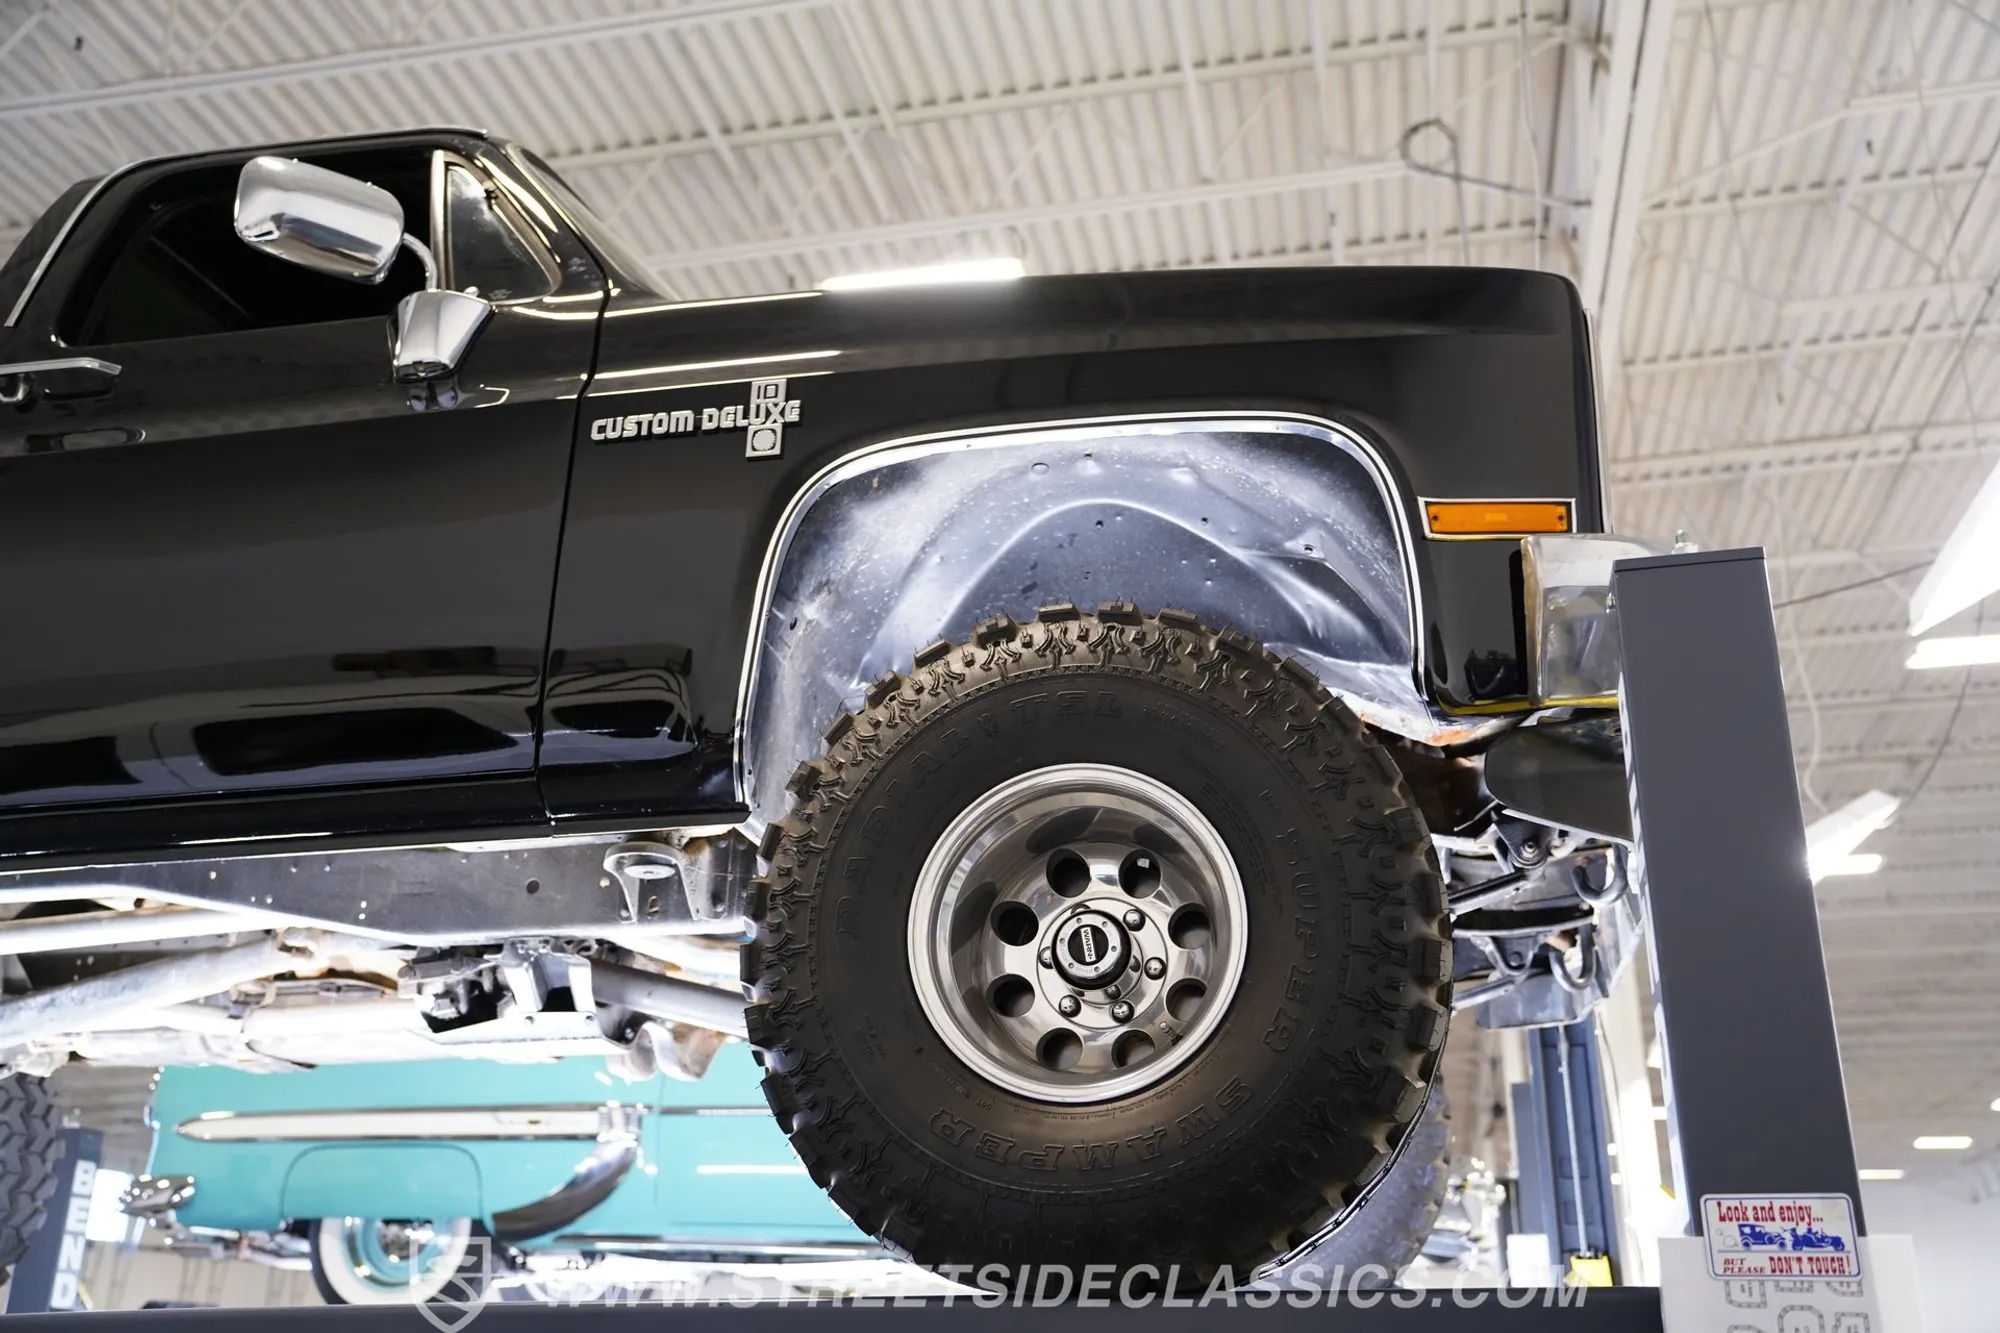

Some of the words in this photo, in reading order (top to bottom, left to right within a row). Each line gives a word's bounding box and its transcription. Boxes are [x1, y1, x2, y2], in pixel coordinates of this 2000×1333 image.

[590, 410, 695, 441] CUSTOM
[701, 400, 801, 431] DELUXE
[1009, 690, 1123, 724] TSL
[1261, 827, 1321, 1052] SUPER
[929, 1073, 1254, 1172] SWAMPER
[1716, 1201, 1749, 1223] Look
[1752, 1201, 1776, 1222] and
[50, 1159, 97, 1310] BEND
[1722, 1266, 1766, 1274] PLEASE
[1723, 1257, 1747, 1266] BUT
[1768, 1256, 1804, 1274] DON'T
[1807, 1255, 1852, 1275] TOUCH!
